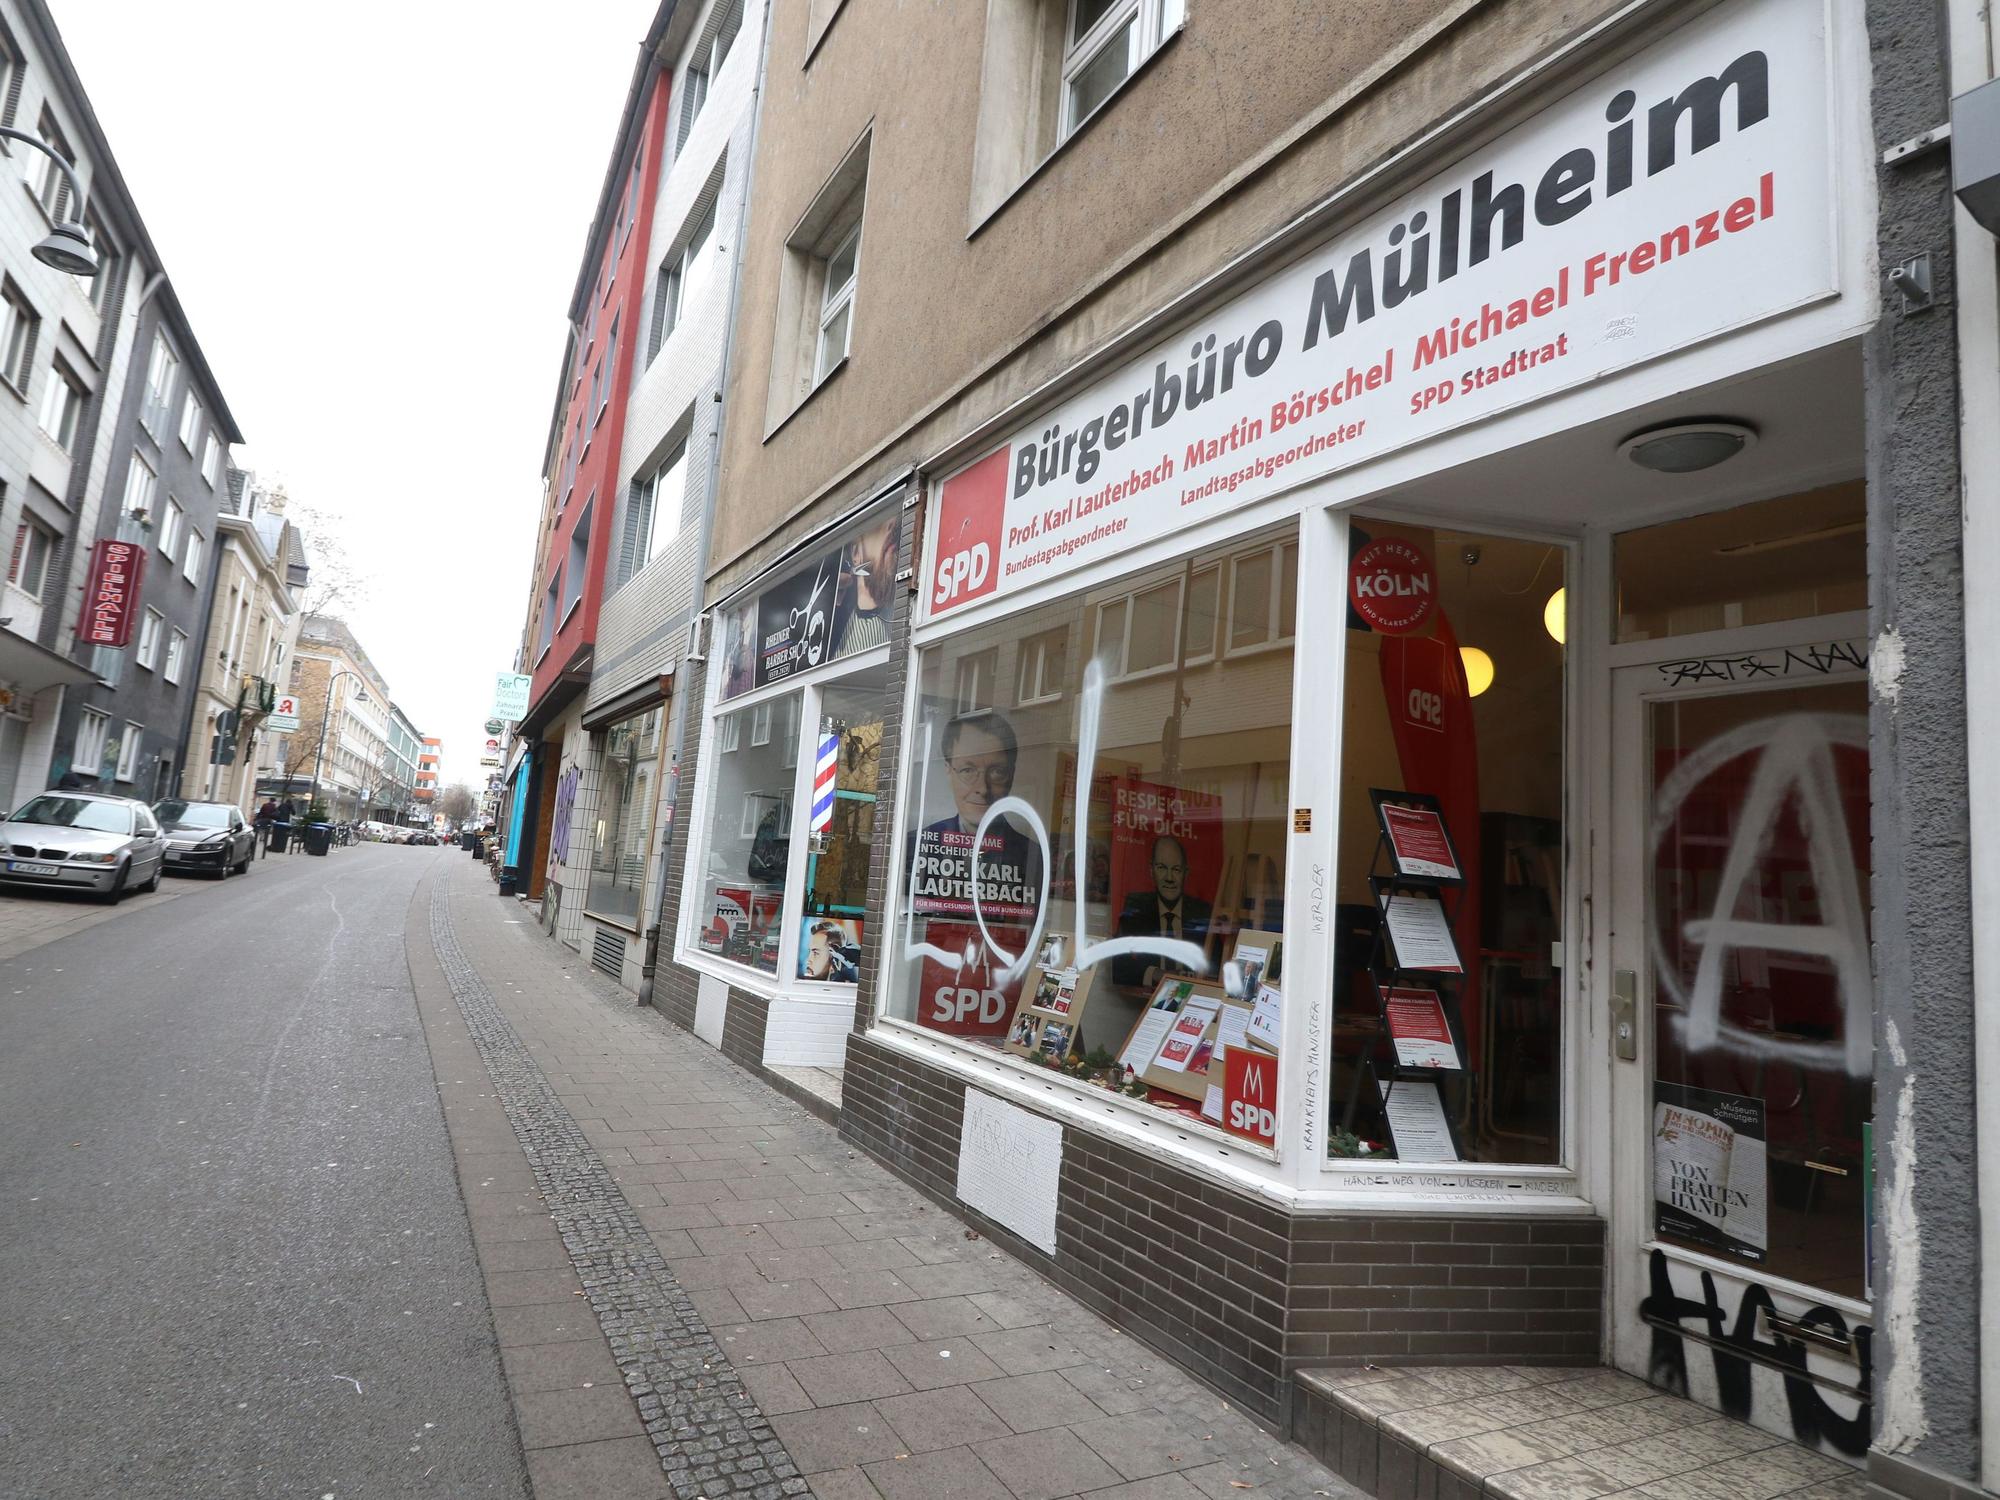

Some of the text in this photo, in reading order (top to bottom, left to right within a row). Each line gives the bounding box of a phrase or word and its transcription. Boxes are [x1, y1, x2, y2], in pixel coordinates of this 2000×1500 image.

[1013, 50, 1769, 500] Bürgerbüro Mülheim
[1411, 171, 1774, 371] Michael Frenzel
[1410, 332, 1568, 415] SPD Stadtrat
[1183, 349, 1393, 472] Martin Börschel
[1180, 419, 1366, 507] Landtagsabgeordneter
[1008, 454, 1174, 549] Prof. Karl Lauterbach
[1005, 516, 1128, 577] Bundestagsabgeordneter
[1361, 544, 1420, 567] MIT HERZ
[934, 541, 991, 604] SPD
[1355, 568, 1430, 598] KÖLN
[93, 543, 131, 641] SPIELHALLE
[1362, 602, 1377, 620] UND
[765, 648, 789, 670] BARBER
[1117, 788, 1187, 816] RESPEKT
[919, 831, 1002, 849] HRE ERSTSTMME
[1116, 808, 1198, 841] FÜR DICH.
[916, 857, 1022, 883] PROF. KARL
[914, 877, 1036, 904] LAUTERBACH
[932, 986, 1006, 1024] SPD
[1230, 1100, 1276, 1137] SPD
[1720, 1102, 1758, 1116] Museum
[1391, 1175, 1414, 1186] WEG
[1420, 1176, 1442, 1187] VON
[1669, 1159, 1709, 1182] VON
[1670, 1176, 1750, 1209] FRAUEN
[1670, 1191, 1728, 1219] HAND
